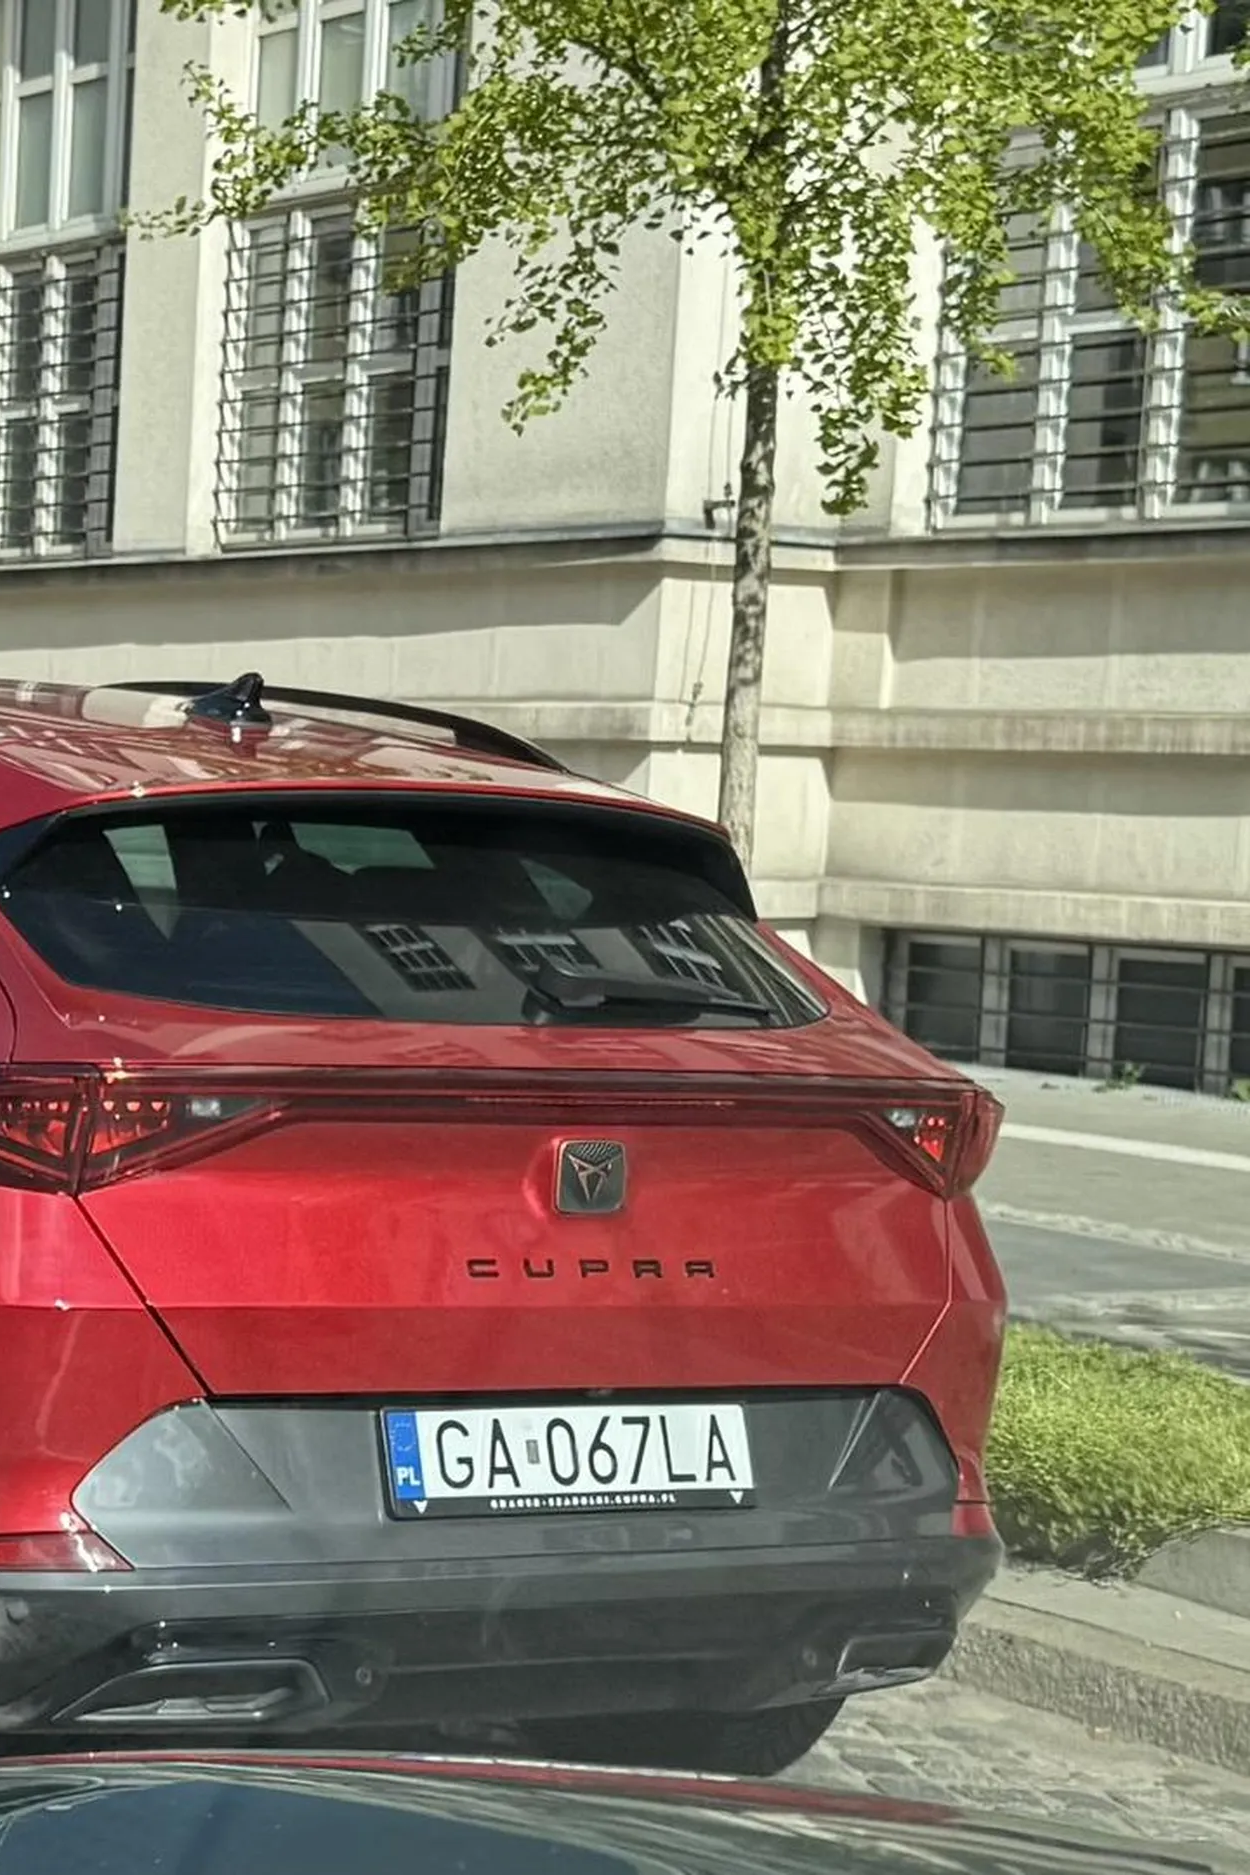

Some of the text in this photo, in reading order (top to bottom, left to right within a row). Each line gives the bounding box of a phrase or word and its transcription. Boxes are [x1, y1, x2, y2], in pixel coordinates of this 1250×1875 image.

[466, 1258, 715, 1278] CUPRA
[435, 1413, 736, 1490] GA 067LA
[397, 1467, 421, 1487] PL
